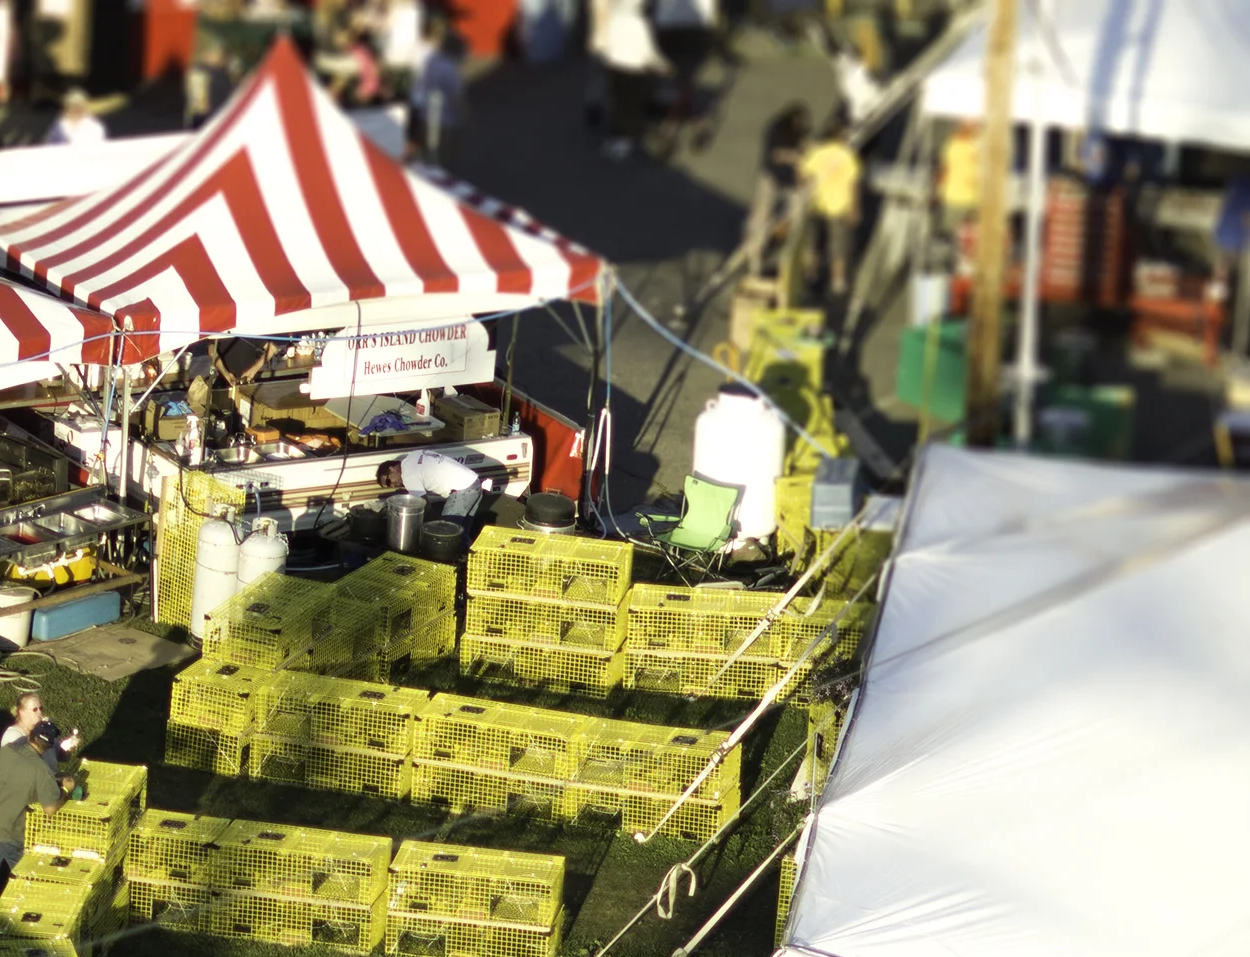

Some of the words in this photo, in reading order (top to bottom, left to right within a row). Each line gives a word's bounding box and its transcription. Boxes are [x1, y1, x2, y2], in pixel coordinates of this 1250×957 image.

[379, 326, 416, 348] ISLAND
[418, 323, 468, 345] CHOWDER
[363, 357, 392, 376] Hewes
[393, 353, 433, 373] Chowder
[434, 352, 448, 369] Co.
